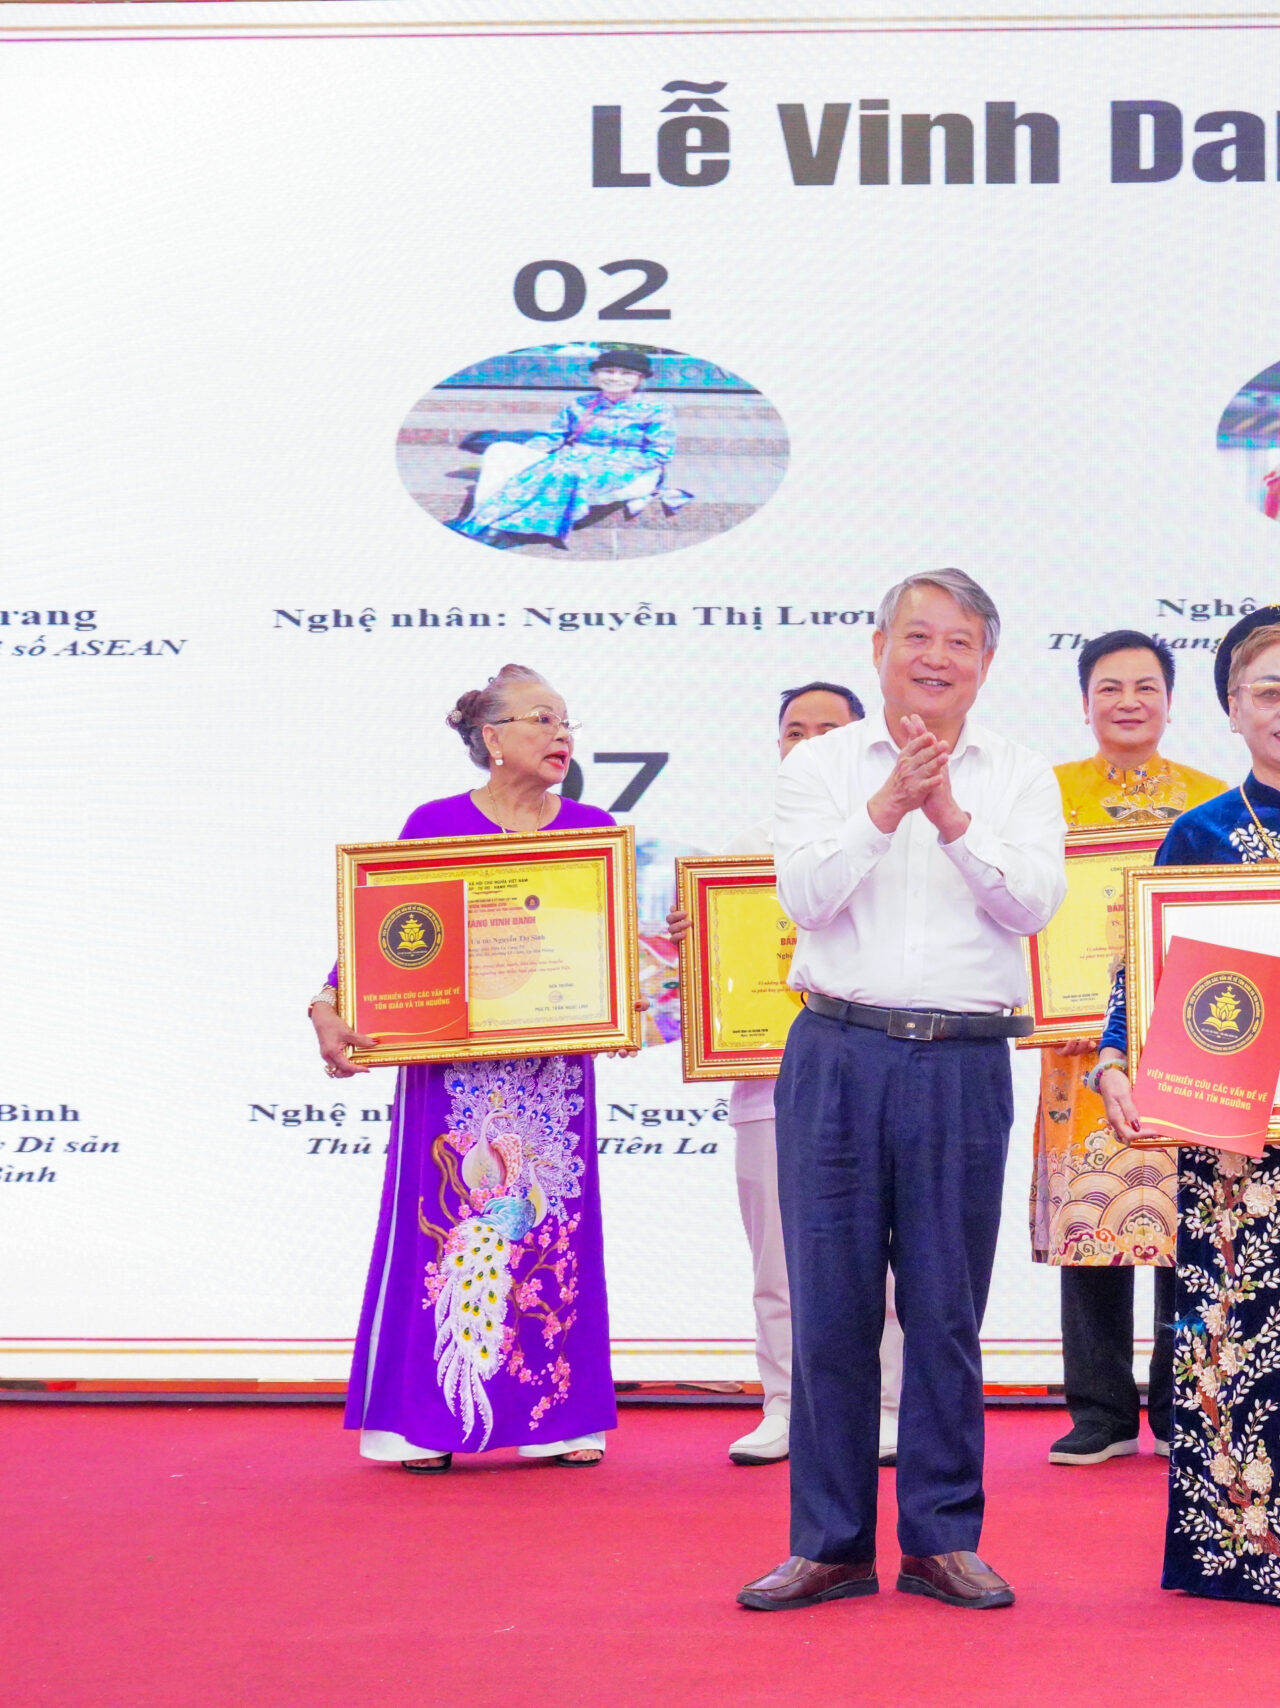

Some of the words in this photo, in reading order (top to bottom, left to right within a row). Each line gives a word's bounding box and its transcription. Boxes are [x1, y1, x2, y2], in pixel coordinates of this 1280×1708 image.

[592, 80, 731, 188] Lễ
[777, 98, 1060, 187] Vinh
[512, 258, 672, 322] 02
[273, 607, 377, 634] Nghệ
[391, 606, 506, 628] nhân:
[523, 601, 678, 632] Nguyễn
[692, 606, 763, 631] Thị
[12, 635, 47, 657] số
[53, 639, 188, 657] ASEAN
[490, 917, 511, 927] VINH
[364, 994, 378, 1002] VIỆN
[379, 992, 402, 1001] NGHIÊN
[418, 988, 430, 998] CÁC
[388, 1000, 404, 1010] GIÁO
[1146, 1068, 1164, 1080] VIỆN
[1164, 1071, 1194, 1086] NGHIÊN
[1194, 1078, 1210, 1090] CỨU
[1212, 1081, 1228, 1094] CÁC
[1230, 1085, 1246, 1098] VẤN
[1246, 1088, 1257, 1100] ĐỀ
[1258, 1091, 1269, 1103] VỀ
[1157, 1081, 1172, 1093] TÔN
[1174, 1084, 1192, 1098] GIÁO
[1194, 1090, 1204, 1100] VÀ
[1206, 1092, 1218, 1104] TÍN
[0, 1104, 80, 1122] Bình
[248, 1102, 347, 1127] Nghệ
[607, 1098, 729, 1127] Nguyễ
[13, 1136, 55, 1153] Di
[63, 1135, 120, 1153] sản
[306, 1136, 372, 1155] Thủ
[597, 1136, 663, 1155] Tiên
[673, 1137, 718, 1155] La
[0, 1164, 56, 1183] ình
